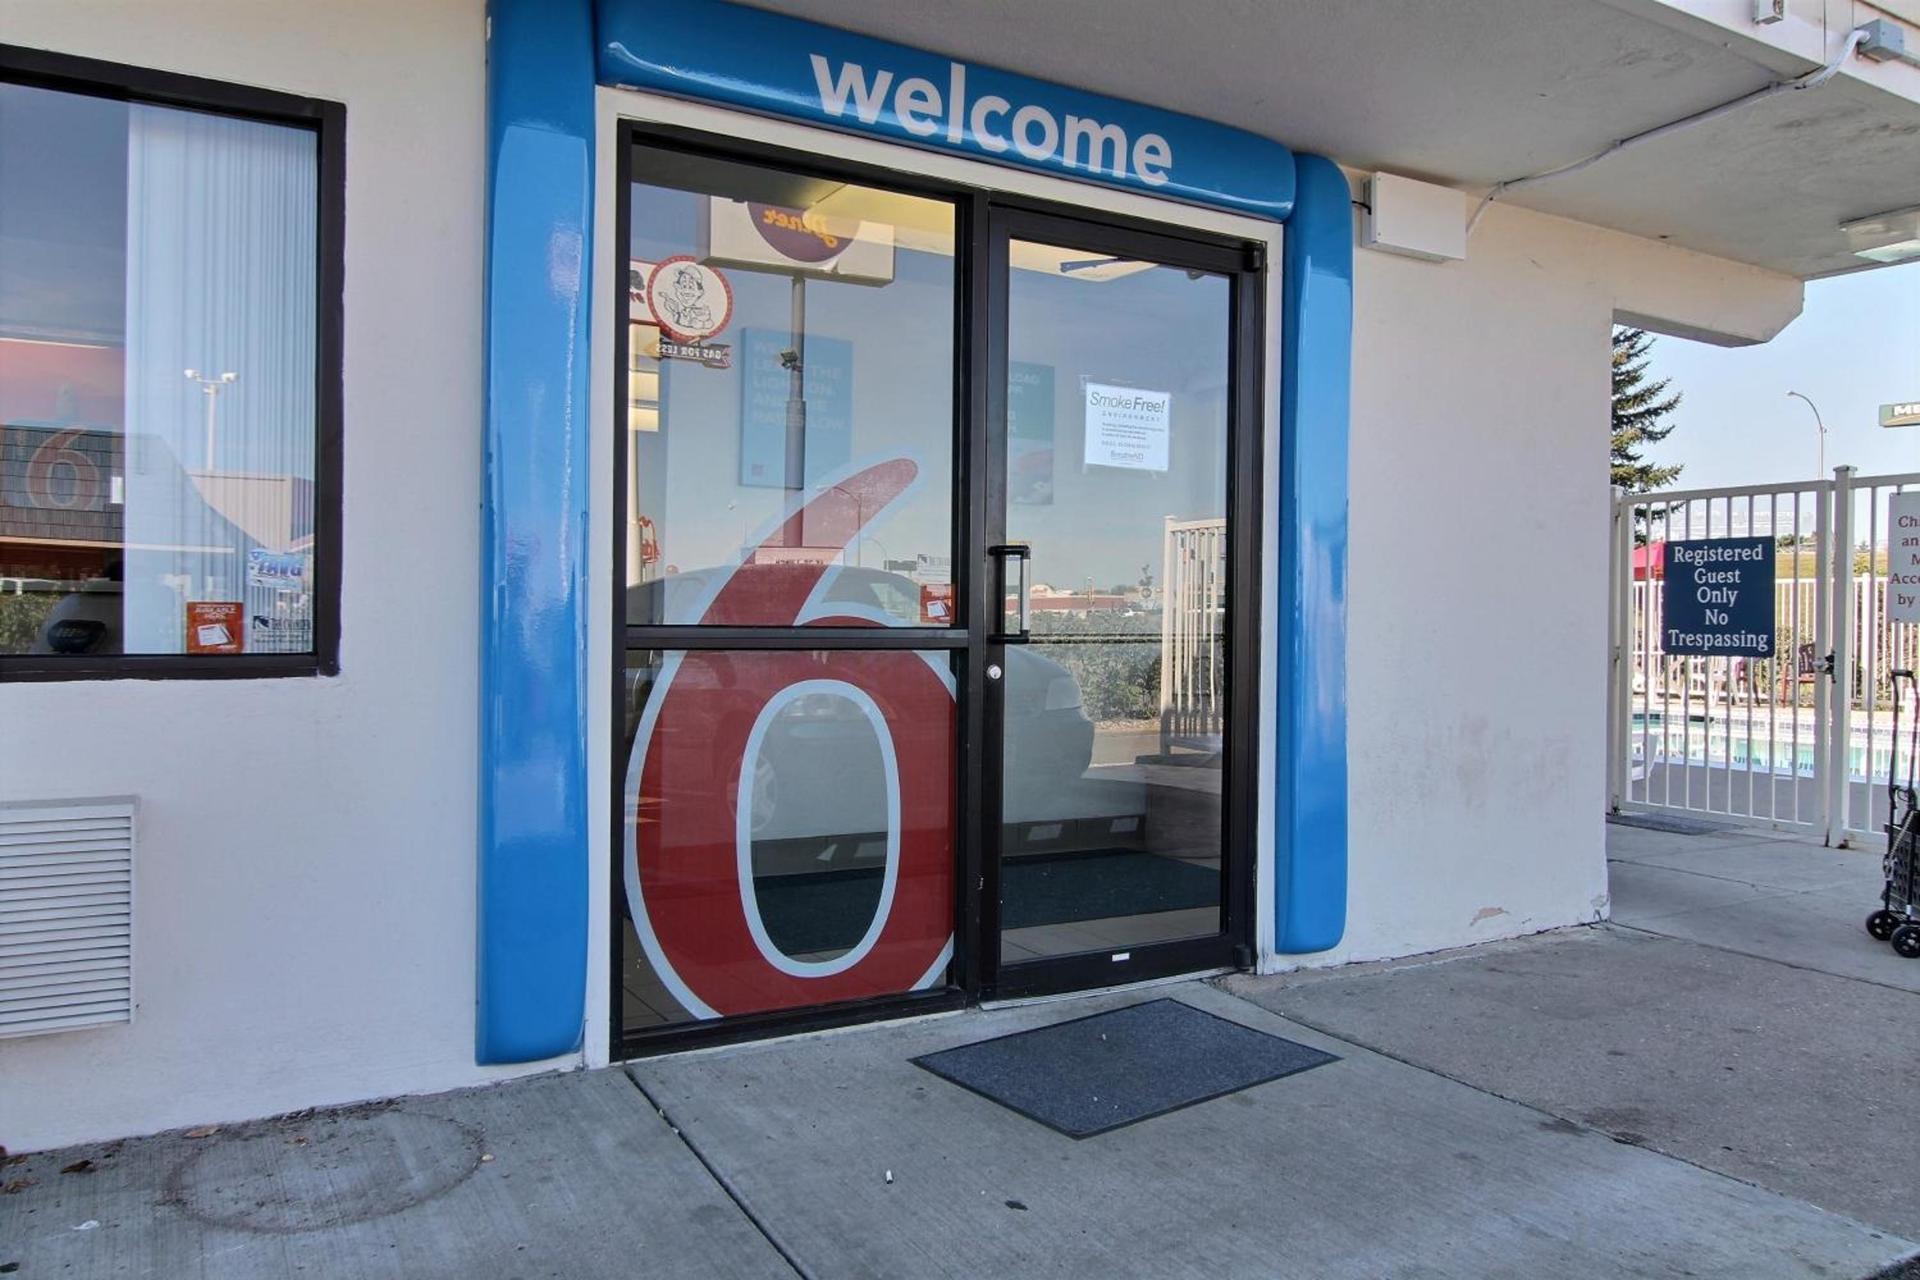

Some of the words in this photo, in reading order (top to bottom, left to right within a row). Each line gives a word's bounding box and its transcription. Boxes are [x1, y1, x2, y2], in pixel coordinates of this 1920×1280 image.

[809, 53, 1173, 186] welcome
[1673, 544, 1764, 567] Registered
[1694, 567, 1741, 584] Guest
[1696, 586, 1739, 608] Only
[1897, 593, 1916, 607] by
[1705, 609, 1729, 626] No
[1667, 629, 1769, 652] Trespassing
[621, 450, 959, 1020] 6
